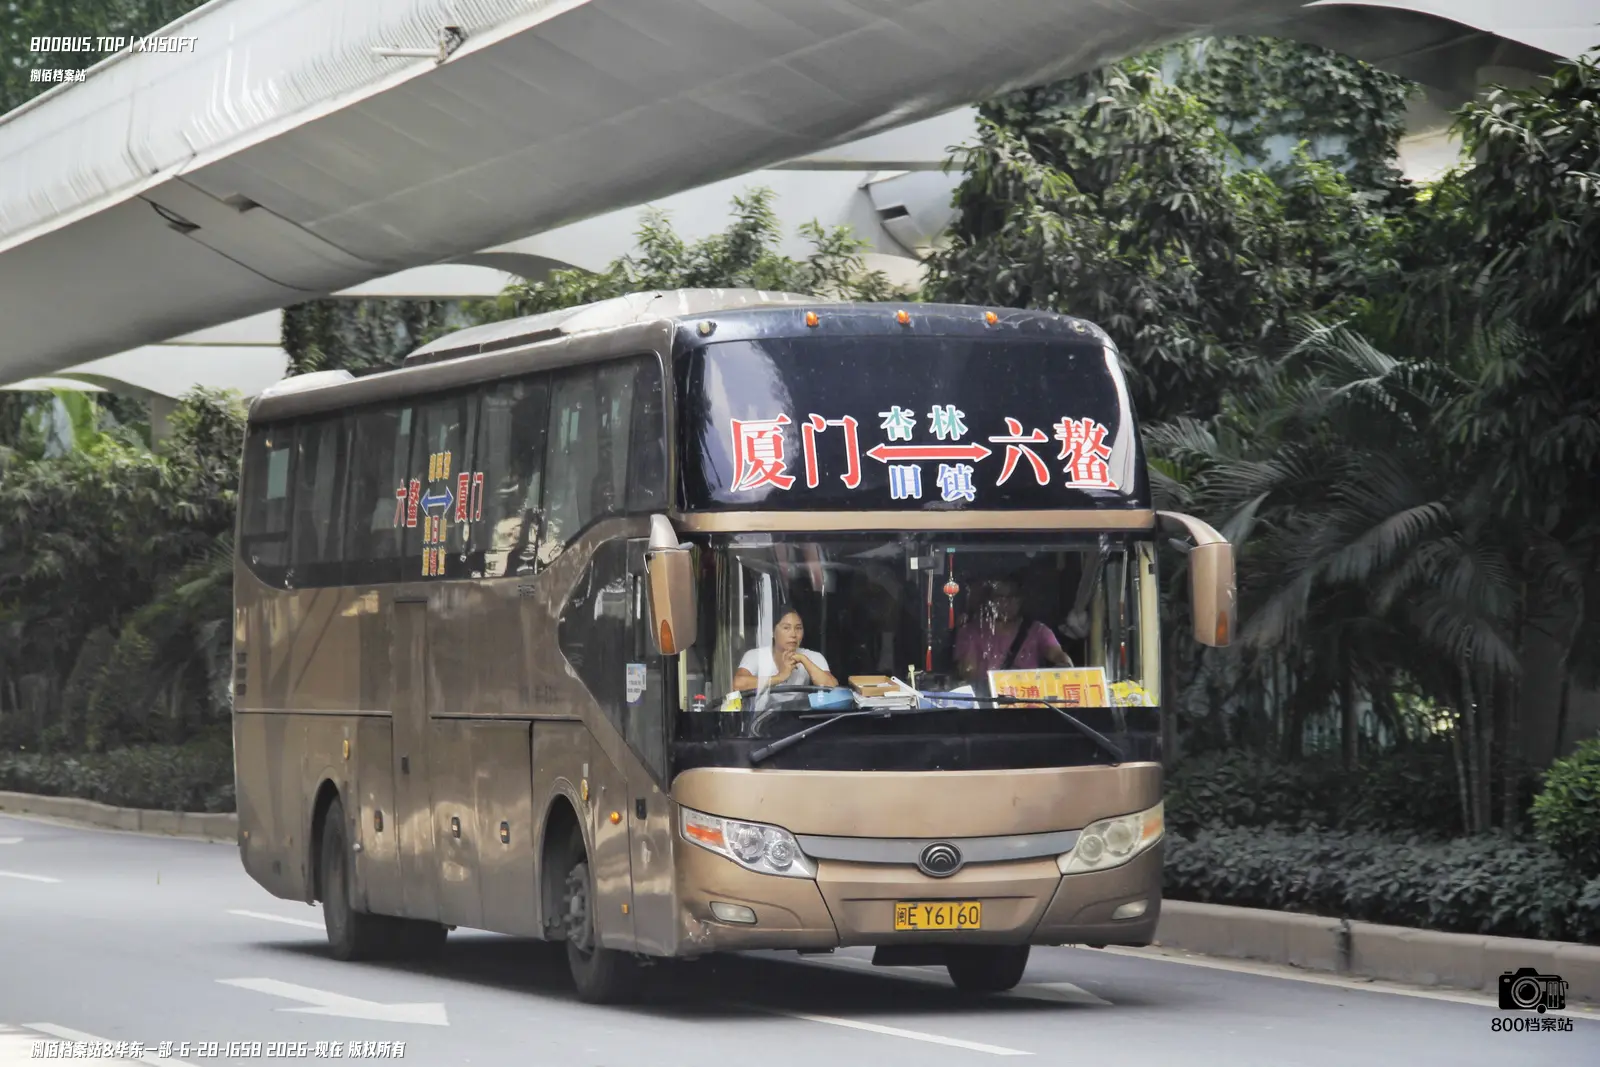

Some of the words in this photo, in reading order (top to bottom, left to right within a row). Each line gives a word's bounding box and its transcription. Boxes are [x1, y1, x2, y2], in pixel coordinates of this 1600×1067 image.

[878, 405, 969, 441] 杏林
[730, 413, 862, 493] 厦门
[988, 416, 1119, 491] 六鳌
[455, 471, 483, 523] 厦门
[888, 463, 975, 502] 旧镇
[924, 905, 979, 926] Y6160
